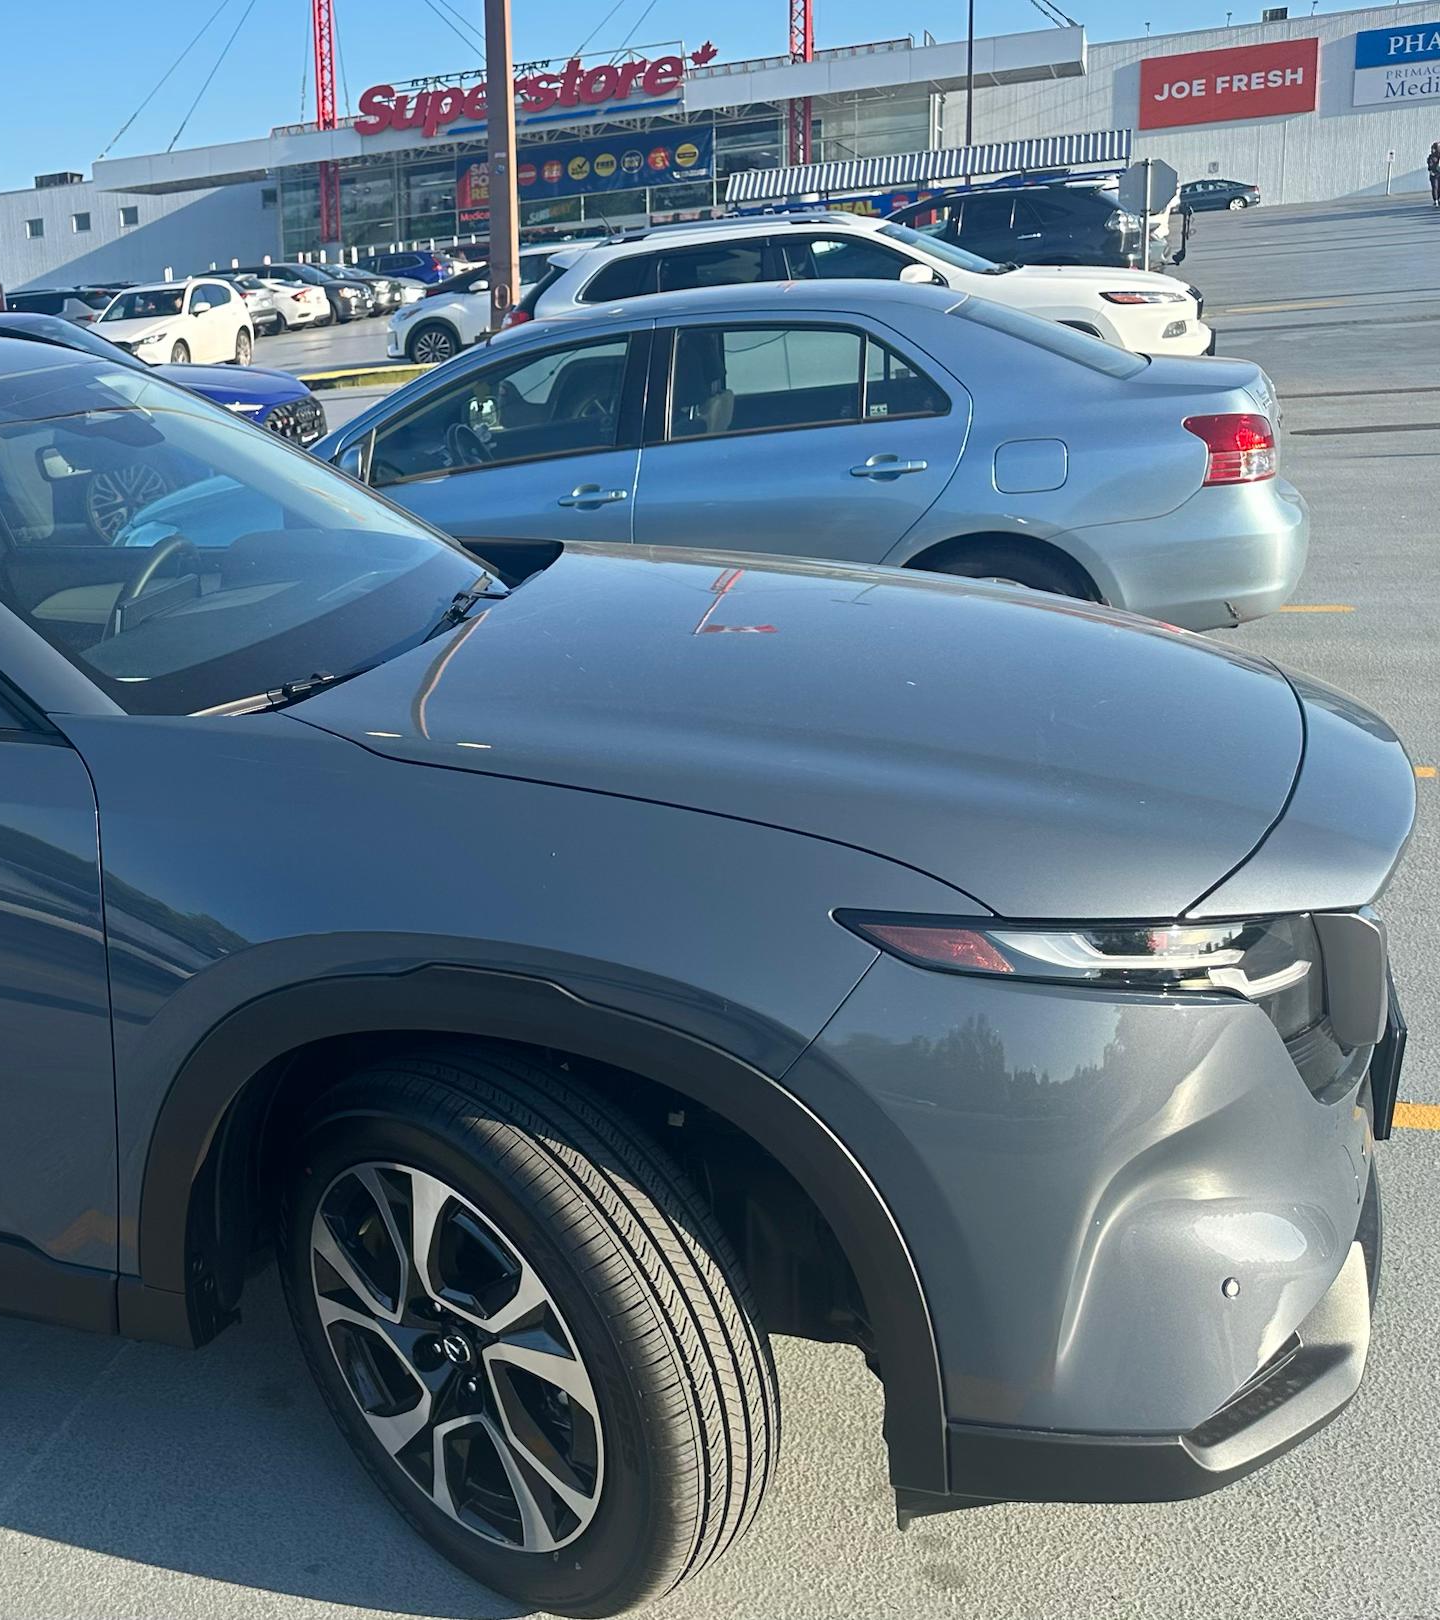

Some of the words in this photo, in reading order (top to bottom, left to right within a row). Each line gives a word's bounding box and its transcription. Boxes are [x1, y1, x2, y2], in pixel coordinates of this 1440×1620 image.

[1387, 32, 1440, 55] PHA
[411, 74, 454, 87] REAL
[461, 60, 550, 79] CADIAN
[1154, 79, 1207, 101] JOE
[1215, 67, 1304, 94] FRESH
[1384, 76, 1440, 98] Medi
[470, 163, 489, 175] SA
[471, 174, 489, 187] FO
[471, 187, 489, 200] RE
[461, 211, 490, 221] Medica
